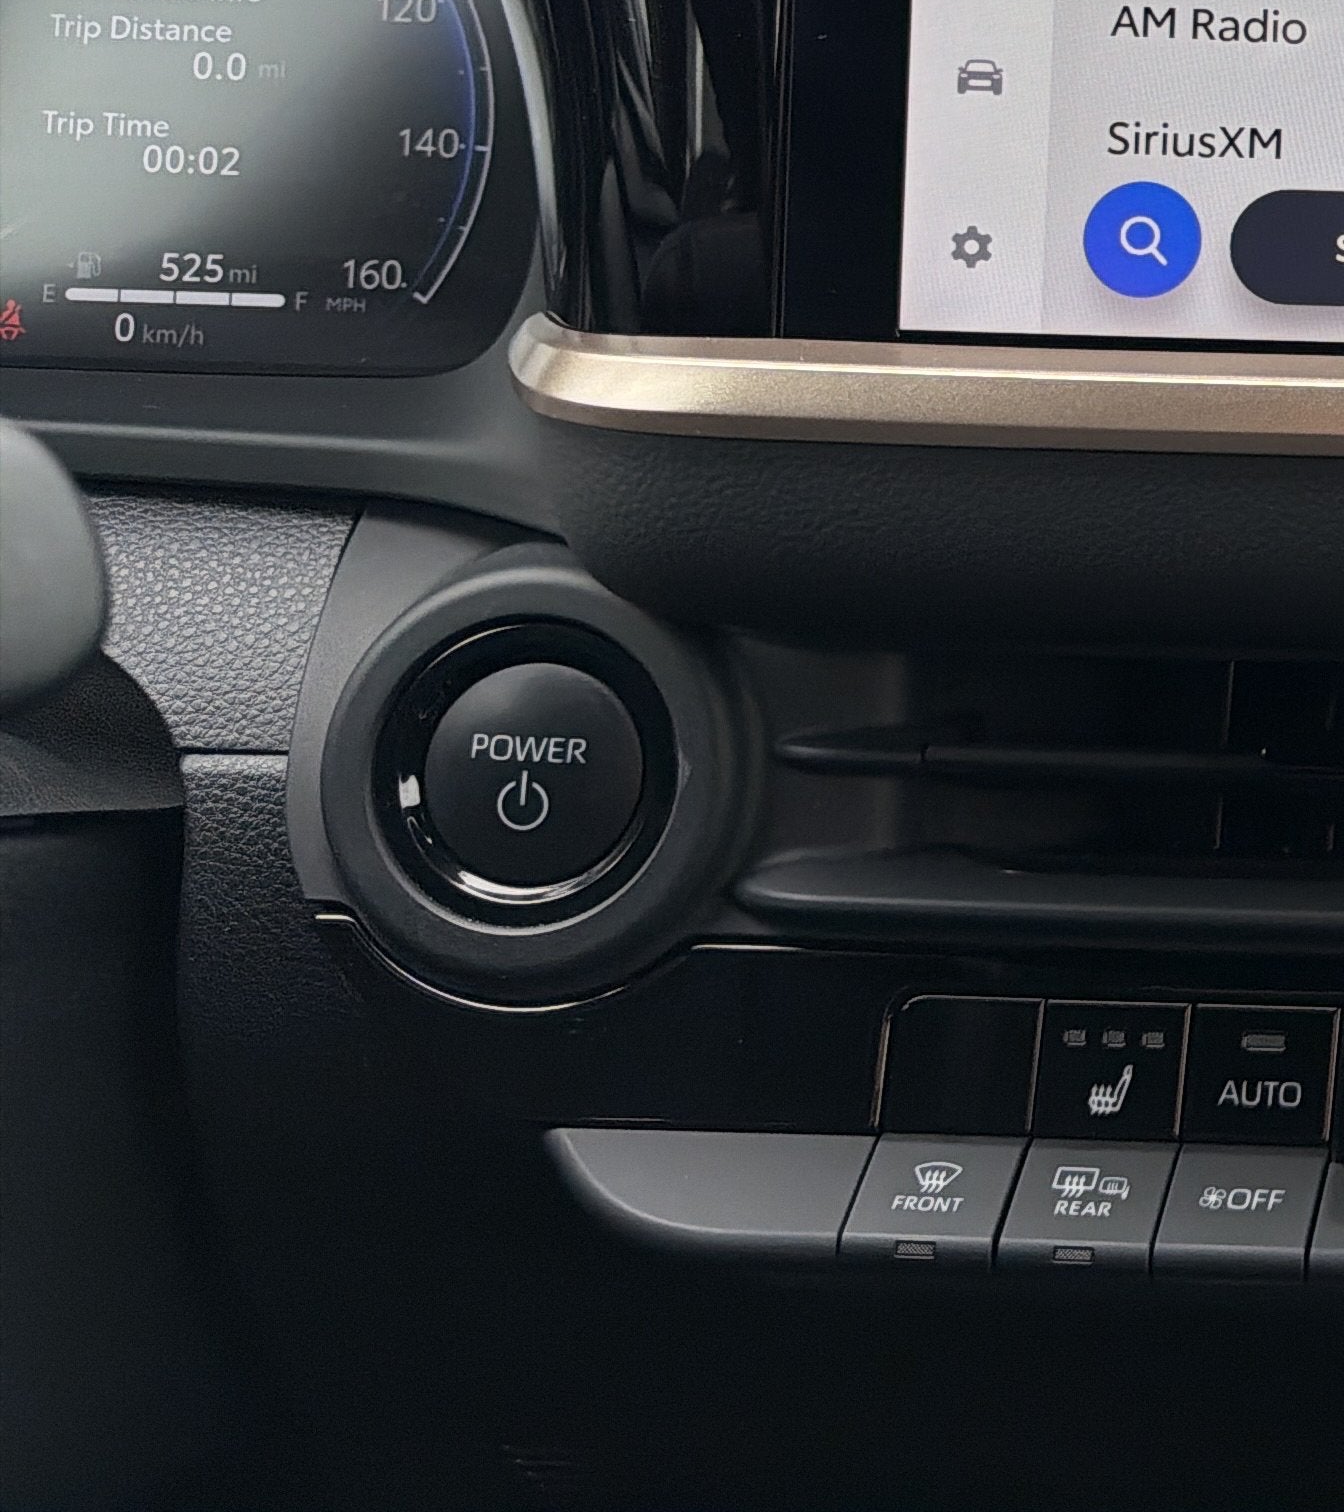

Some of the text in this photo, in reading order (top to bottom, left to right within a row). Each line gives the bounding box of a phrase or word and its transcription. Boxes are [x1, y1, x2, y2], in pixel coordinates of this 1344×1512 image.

[50, 13, 232, 45] Trip Distance
[1110, 5, 1307, 45] AM Radio
[193, 51, 288, 81] 0.0 mi
[42, 110, 170, 142] Trip Time
[1107, 121, 1282, 160] SiriusXM
[399, 127, 459, 158] 140
[142, 148, 240, 176] 00:02
[159, 252, 257, 284] 525 mi
[342, 258, 402, 290] 160
[43, 284, 308, 311] E F
[325, 297, 366, 312] MPH
[114, 312, 204, 348] 0 km/h
[471, 733, 587, 764] POWER
[1217, 1079, 1302, 1107] AUTO
[891, 1195, 964, 1212] FRONT
[1053, 1200, 1112, 1217] REAR
[1226, 1188, 1286, 1211] OFF
